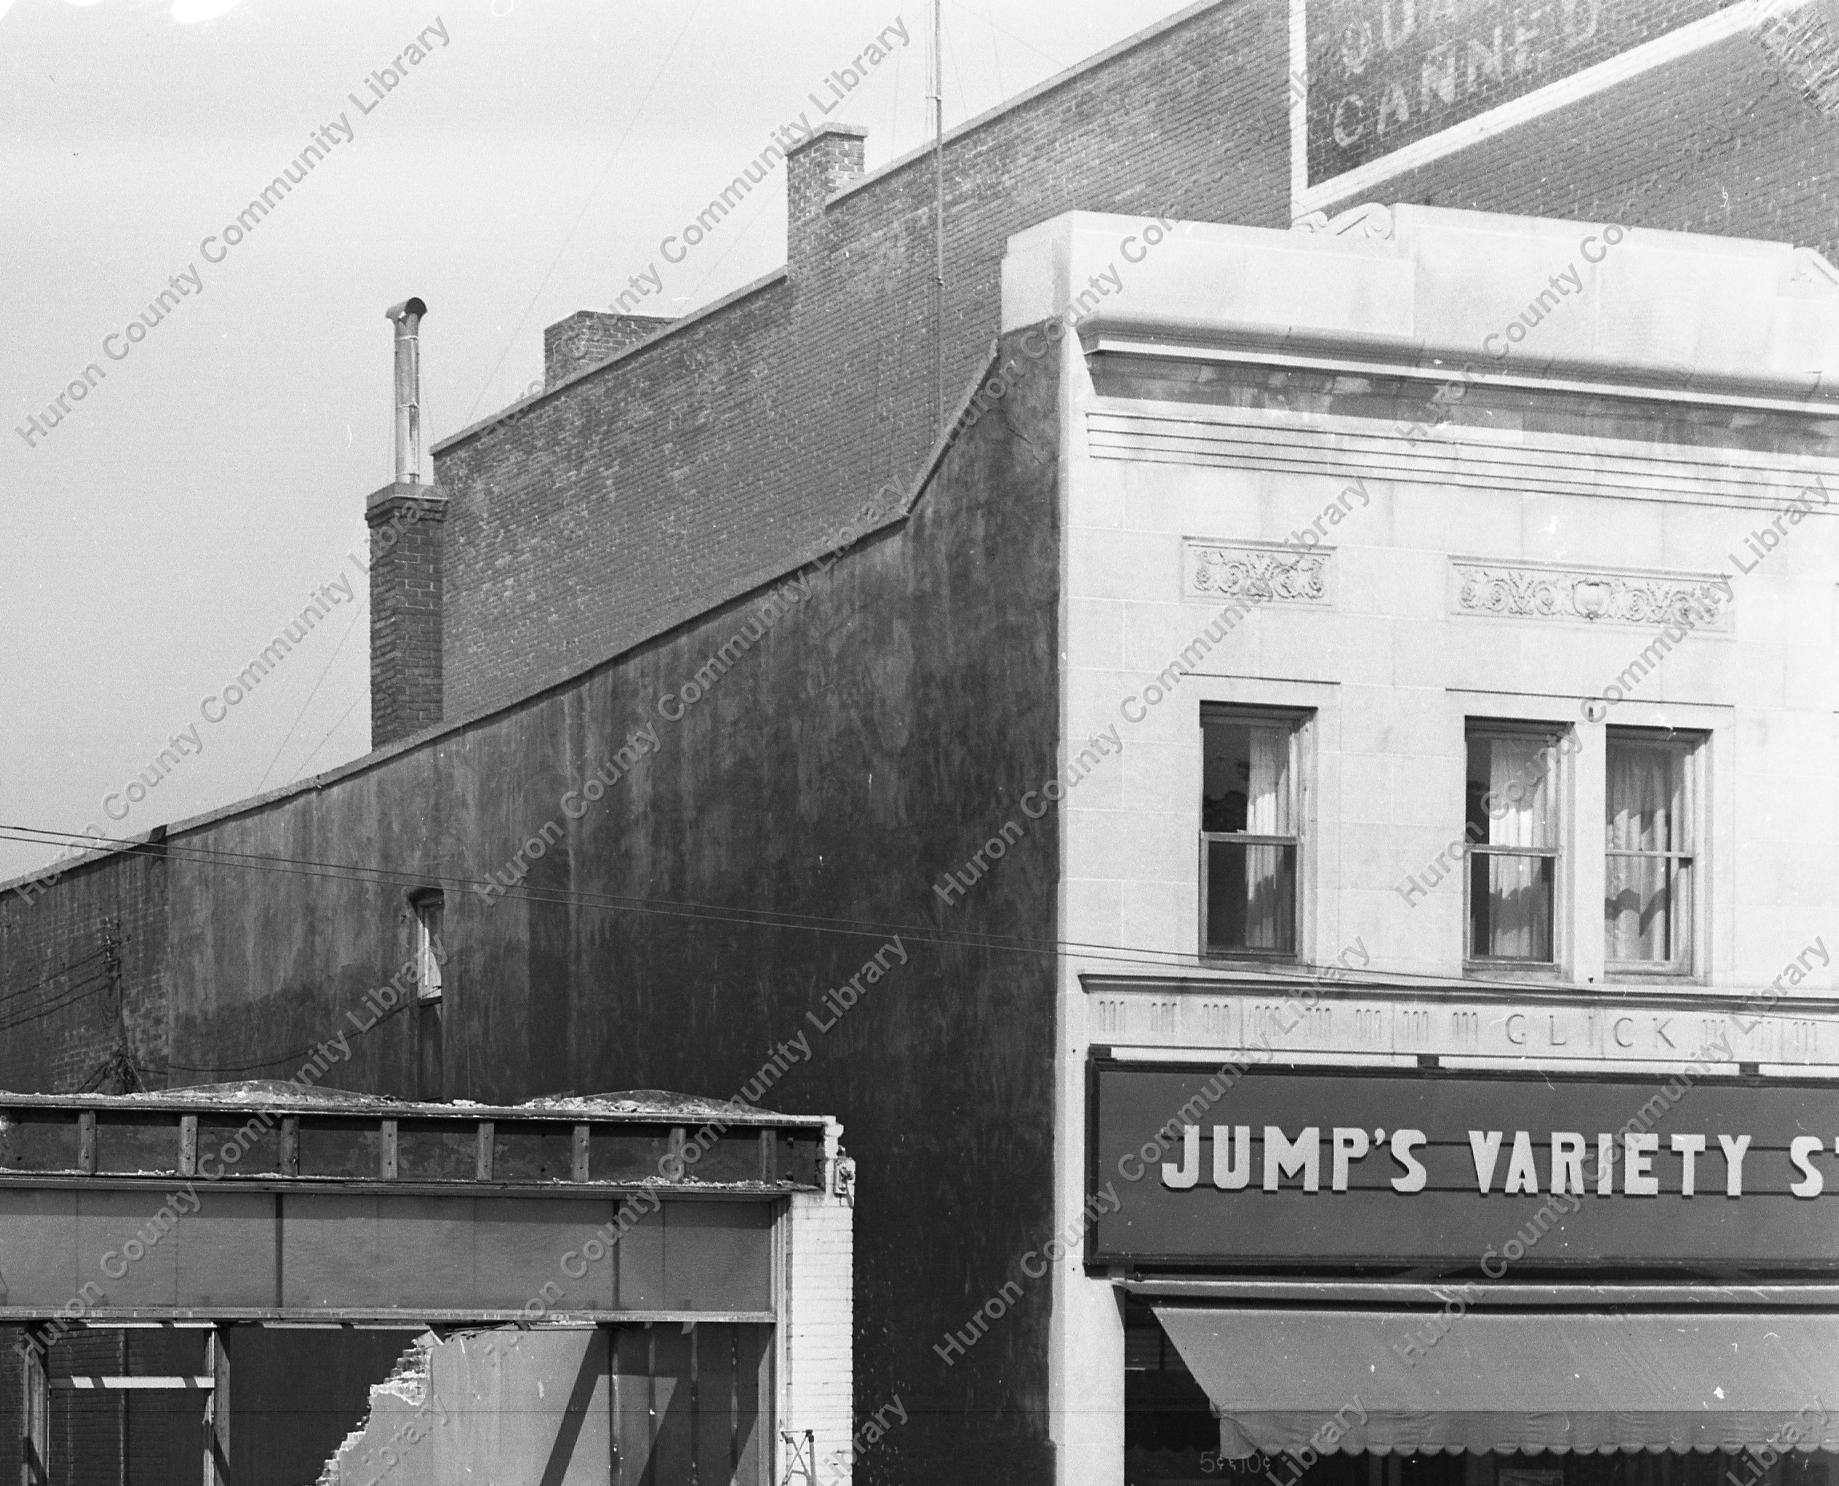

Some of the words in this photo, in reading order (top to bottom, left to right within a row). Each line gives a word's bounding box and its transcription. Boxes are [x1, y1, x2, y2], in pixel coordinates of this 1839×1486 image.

[1505, 1013, 1676, 1049] GLICK
[1161, 1124, 1428, 1193] JUMP'S
[1467, 1130, 1751, 1198] VARIETY
[1790, 1136, 1839, 1198] S
